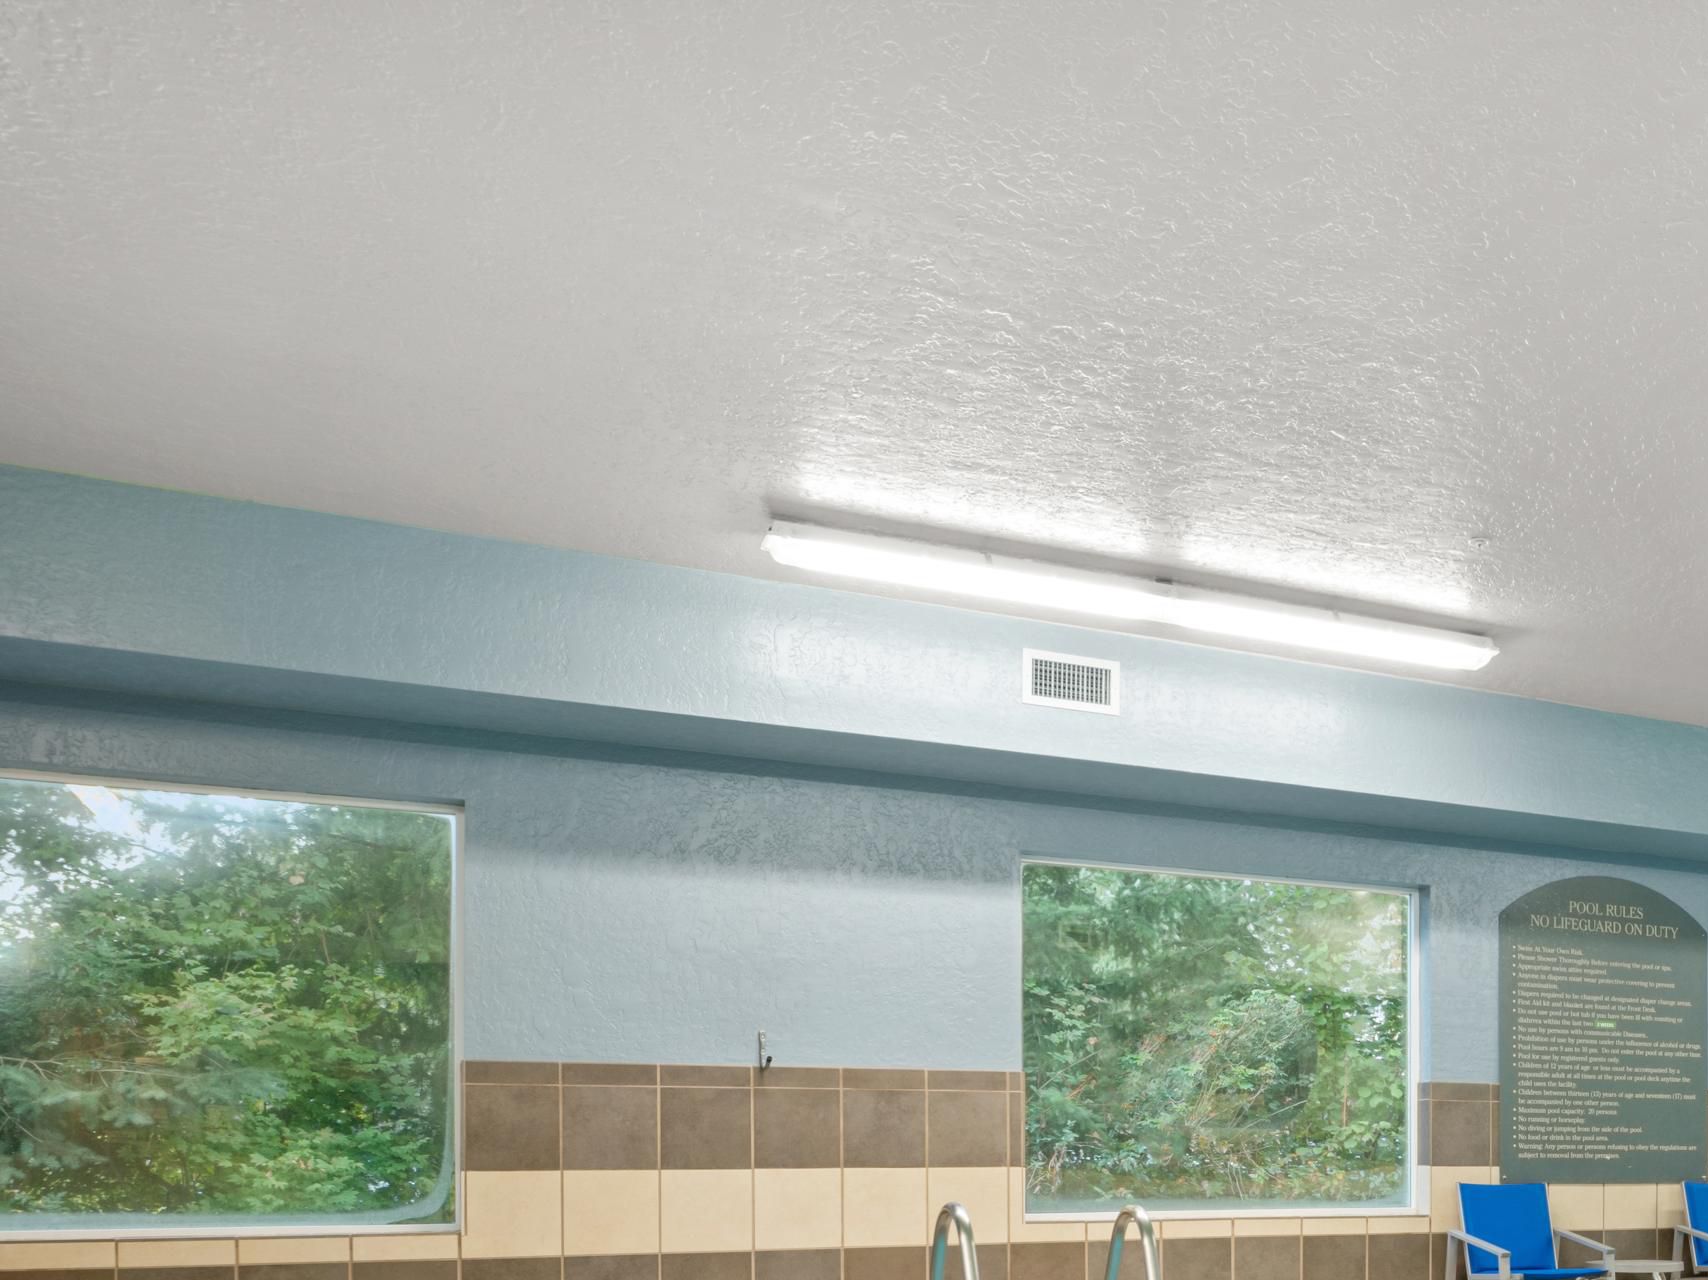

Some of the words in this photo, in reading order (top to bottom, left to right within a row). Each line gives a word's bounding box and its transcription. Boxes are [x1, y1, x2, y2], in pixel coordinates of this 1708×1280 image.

[1569, 901, 1603, 916] POOL
[1606, 904, 1644, 919] RULES
[1530, 914, 1550, 929] NO
[1553, 916, 1622, 935] LIFEGUARD
[1625, 923, 1643, 936] ON
[1646, 924, 1679, 939] DUTY
